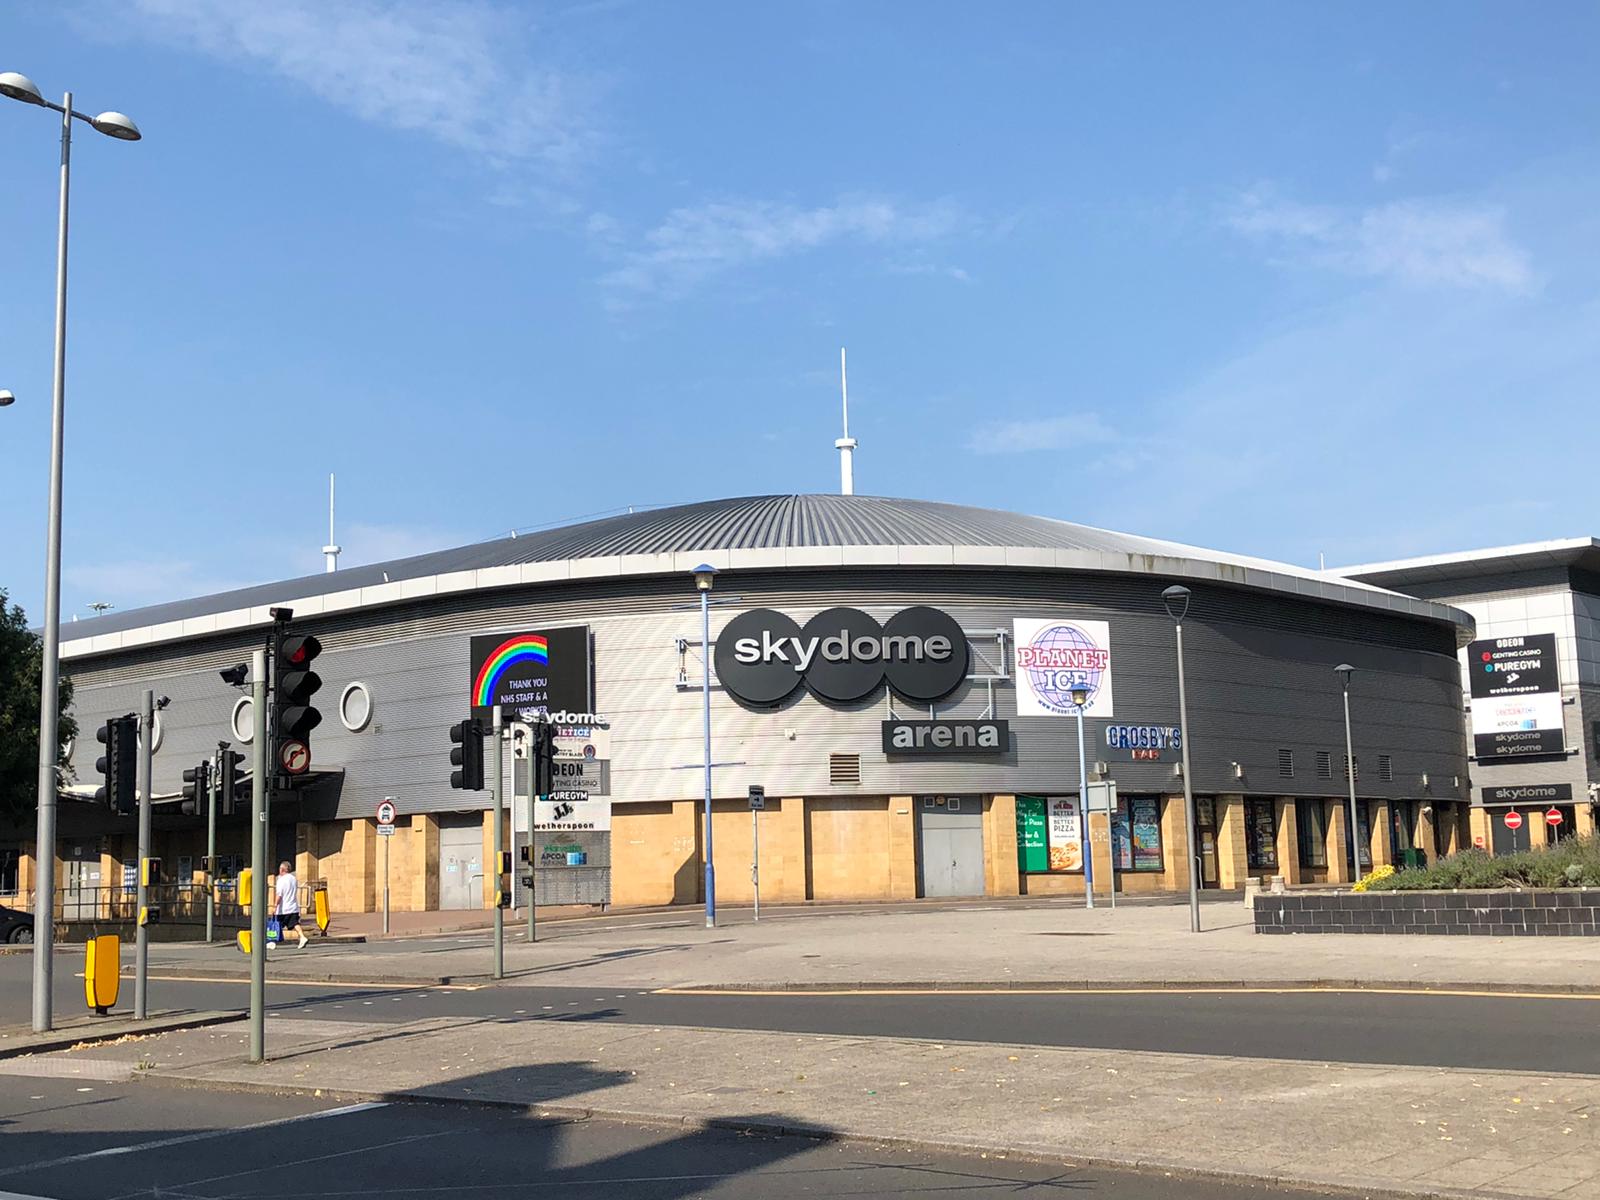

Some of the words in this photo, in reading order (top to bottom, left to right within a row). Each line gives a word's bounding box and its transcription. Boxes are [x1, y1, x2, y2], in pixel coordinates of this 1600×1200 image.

[1496, 637, 1525, 648] ODEON
[734, 629, 952, 671] skydome
[1519, 649, 1542, 657] CASINO
[1017, 647, 1108, 669] PLANET
[1494, 660, 1541, 672] PUREGYM
[509, 679, 532, 690] THANK
[533, 677, 548, 687] YOU
[500, 694, 515, 704] NHS
[515, 692, 534, 703] STAFF
[535, 692, 542, 701] &
[892, 725, 999, 748] arena
[1105, 725, 1182, 750] CROSBY'S
[1495, 732, 1541, 743] skydome
[1496, 744, 1542, 754] skydome
[553, 763, 584, 776] DEON
[1495, 787, 1557, 800] skydome
[541, 852, 566, 860] APCOA
